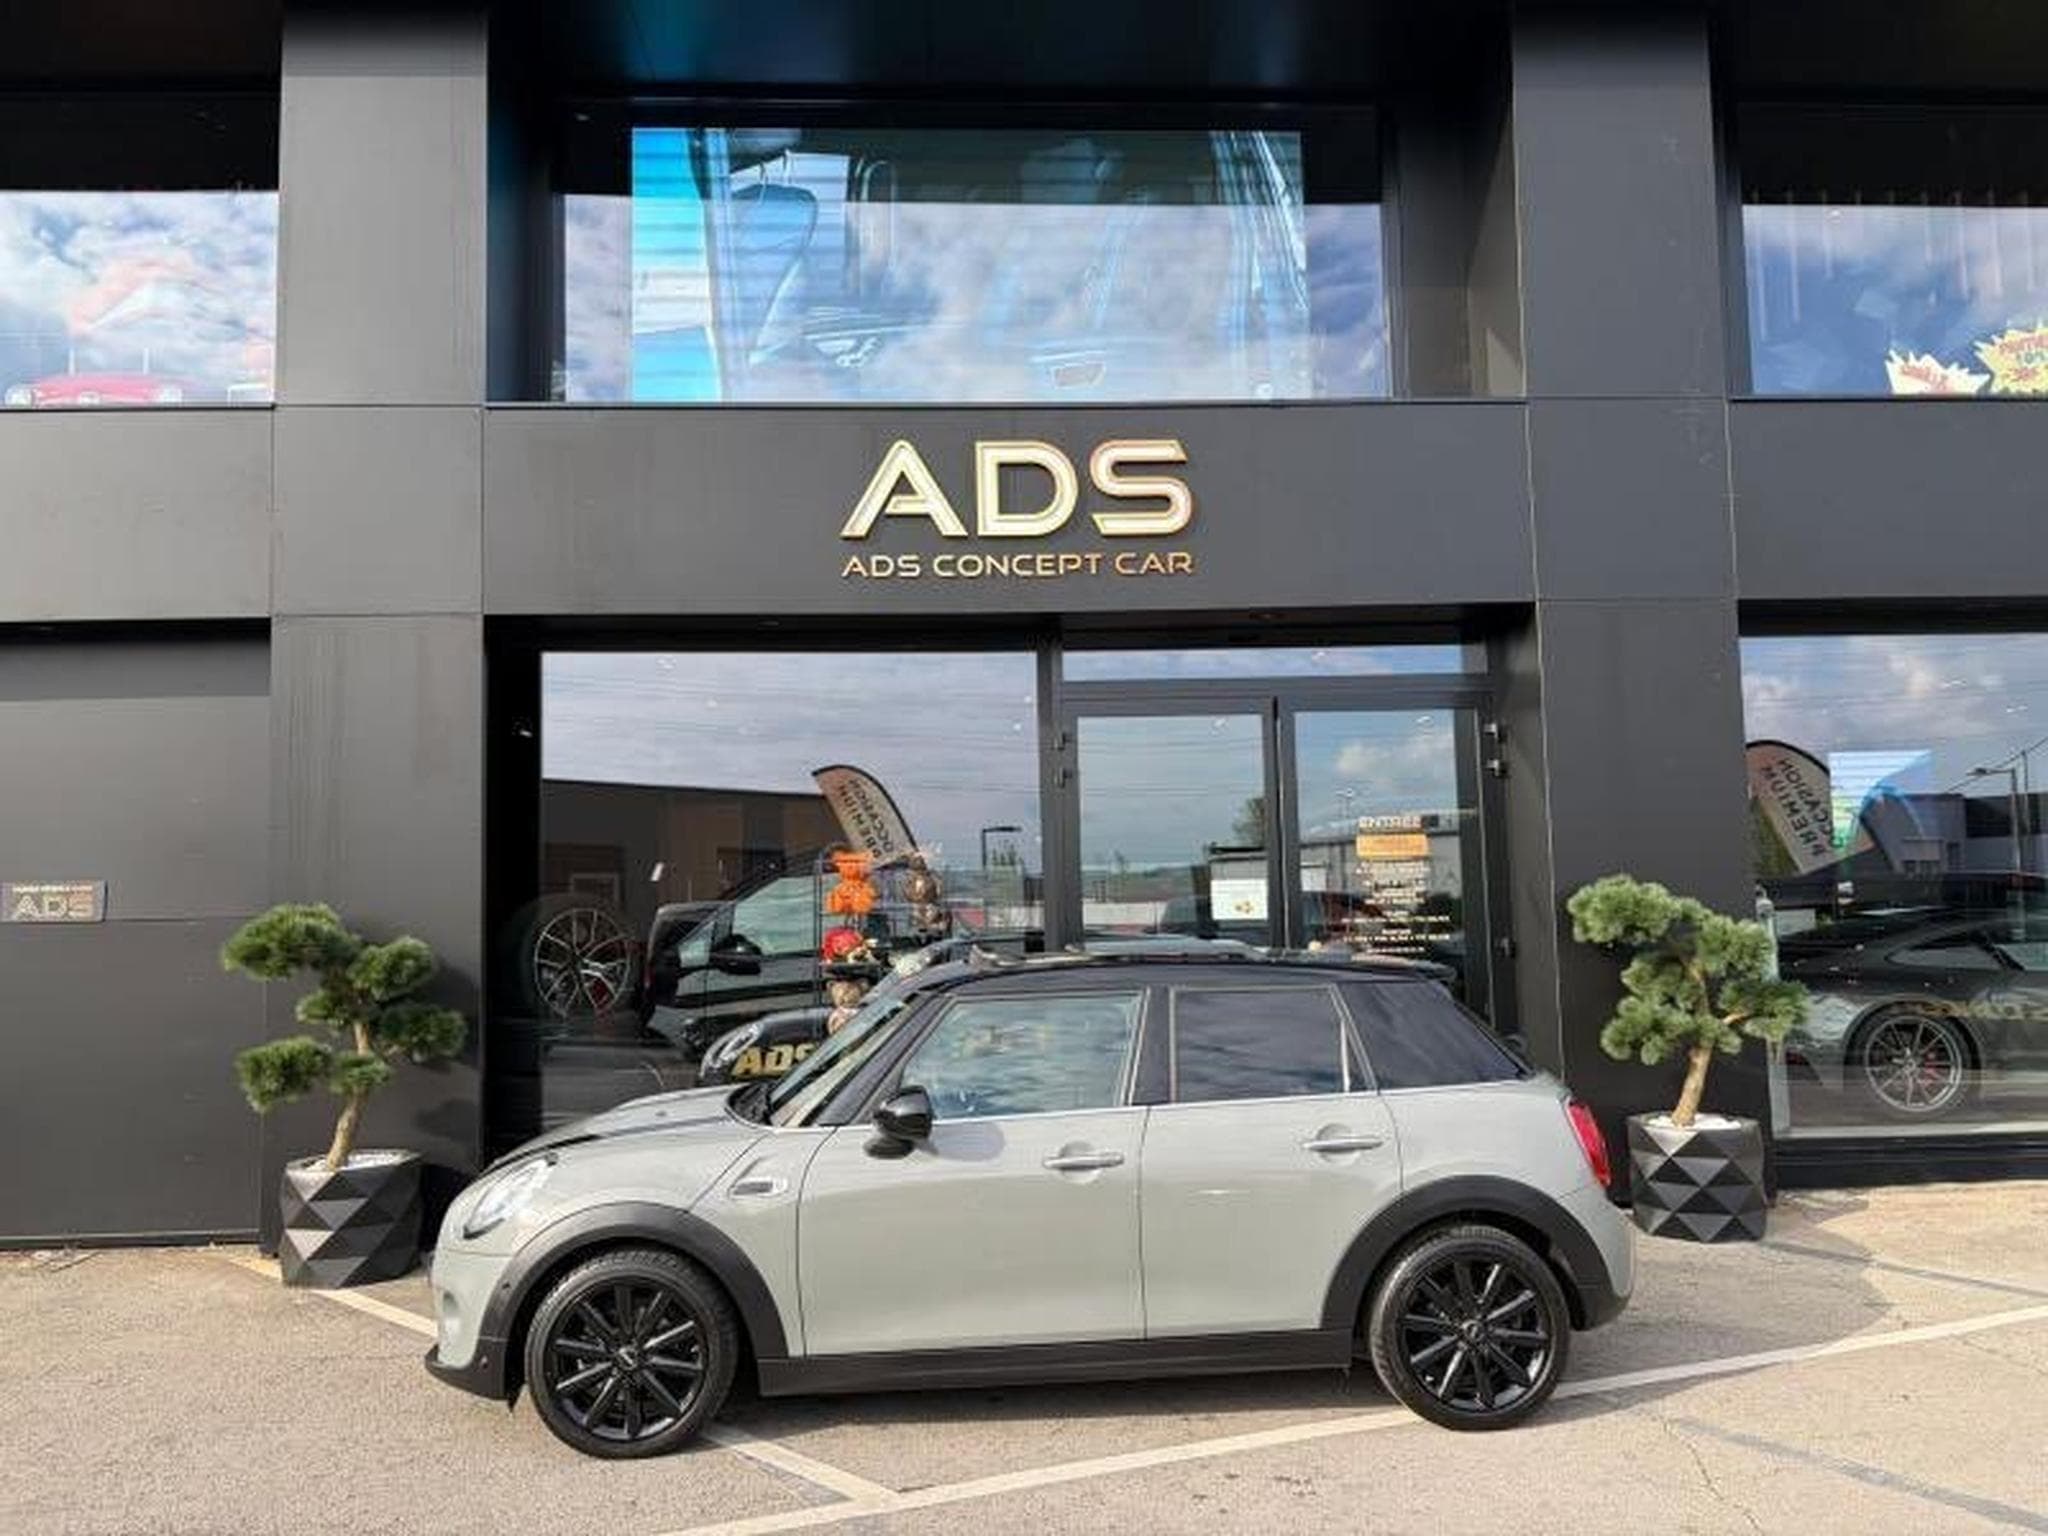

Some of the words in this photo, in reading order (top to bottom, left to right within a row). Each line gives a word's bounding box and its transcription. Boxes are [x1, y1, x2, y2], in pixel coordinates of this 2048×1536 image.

[840, 438, 1193, 538] ADS
[841, 554, 921, 578] ADS
[932, 553, 1102, 578] CONCEPT
[1115, 552, 1193, 576] CAR
